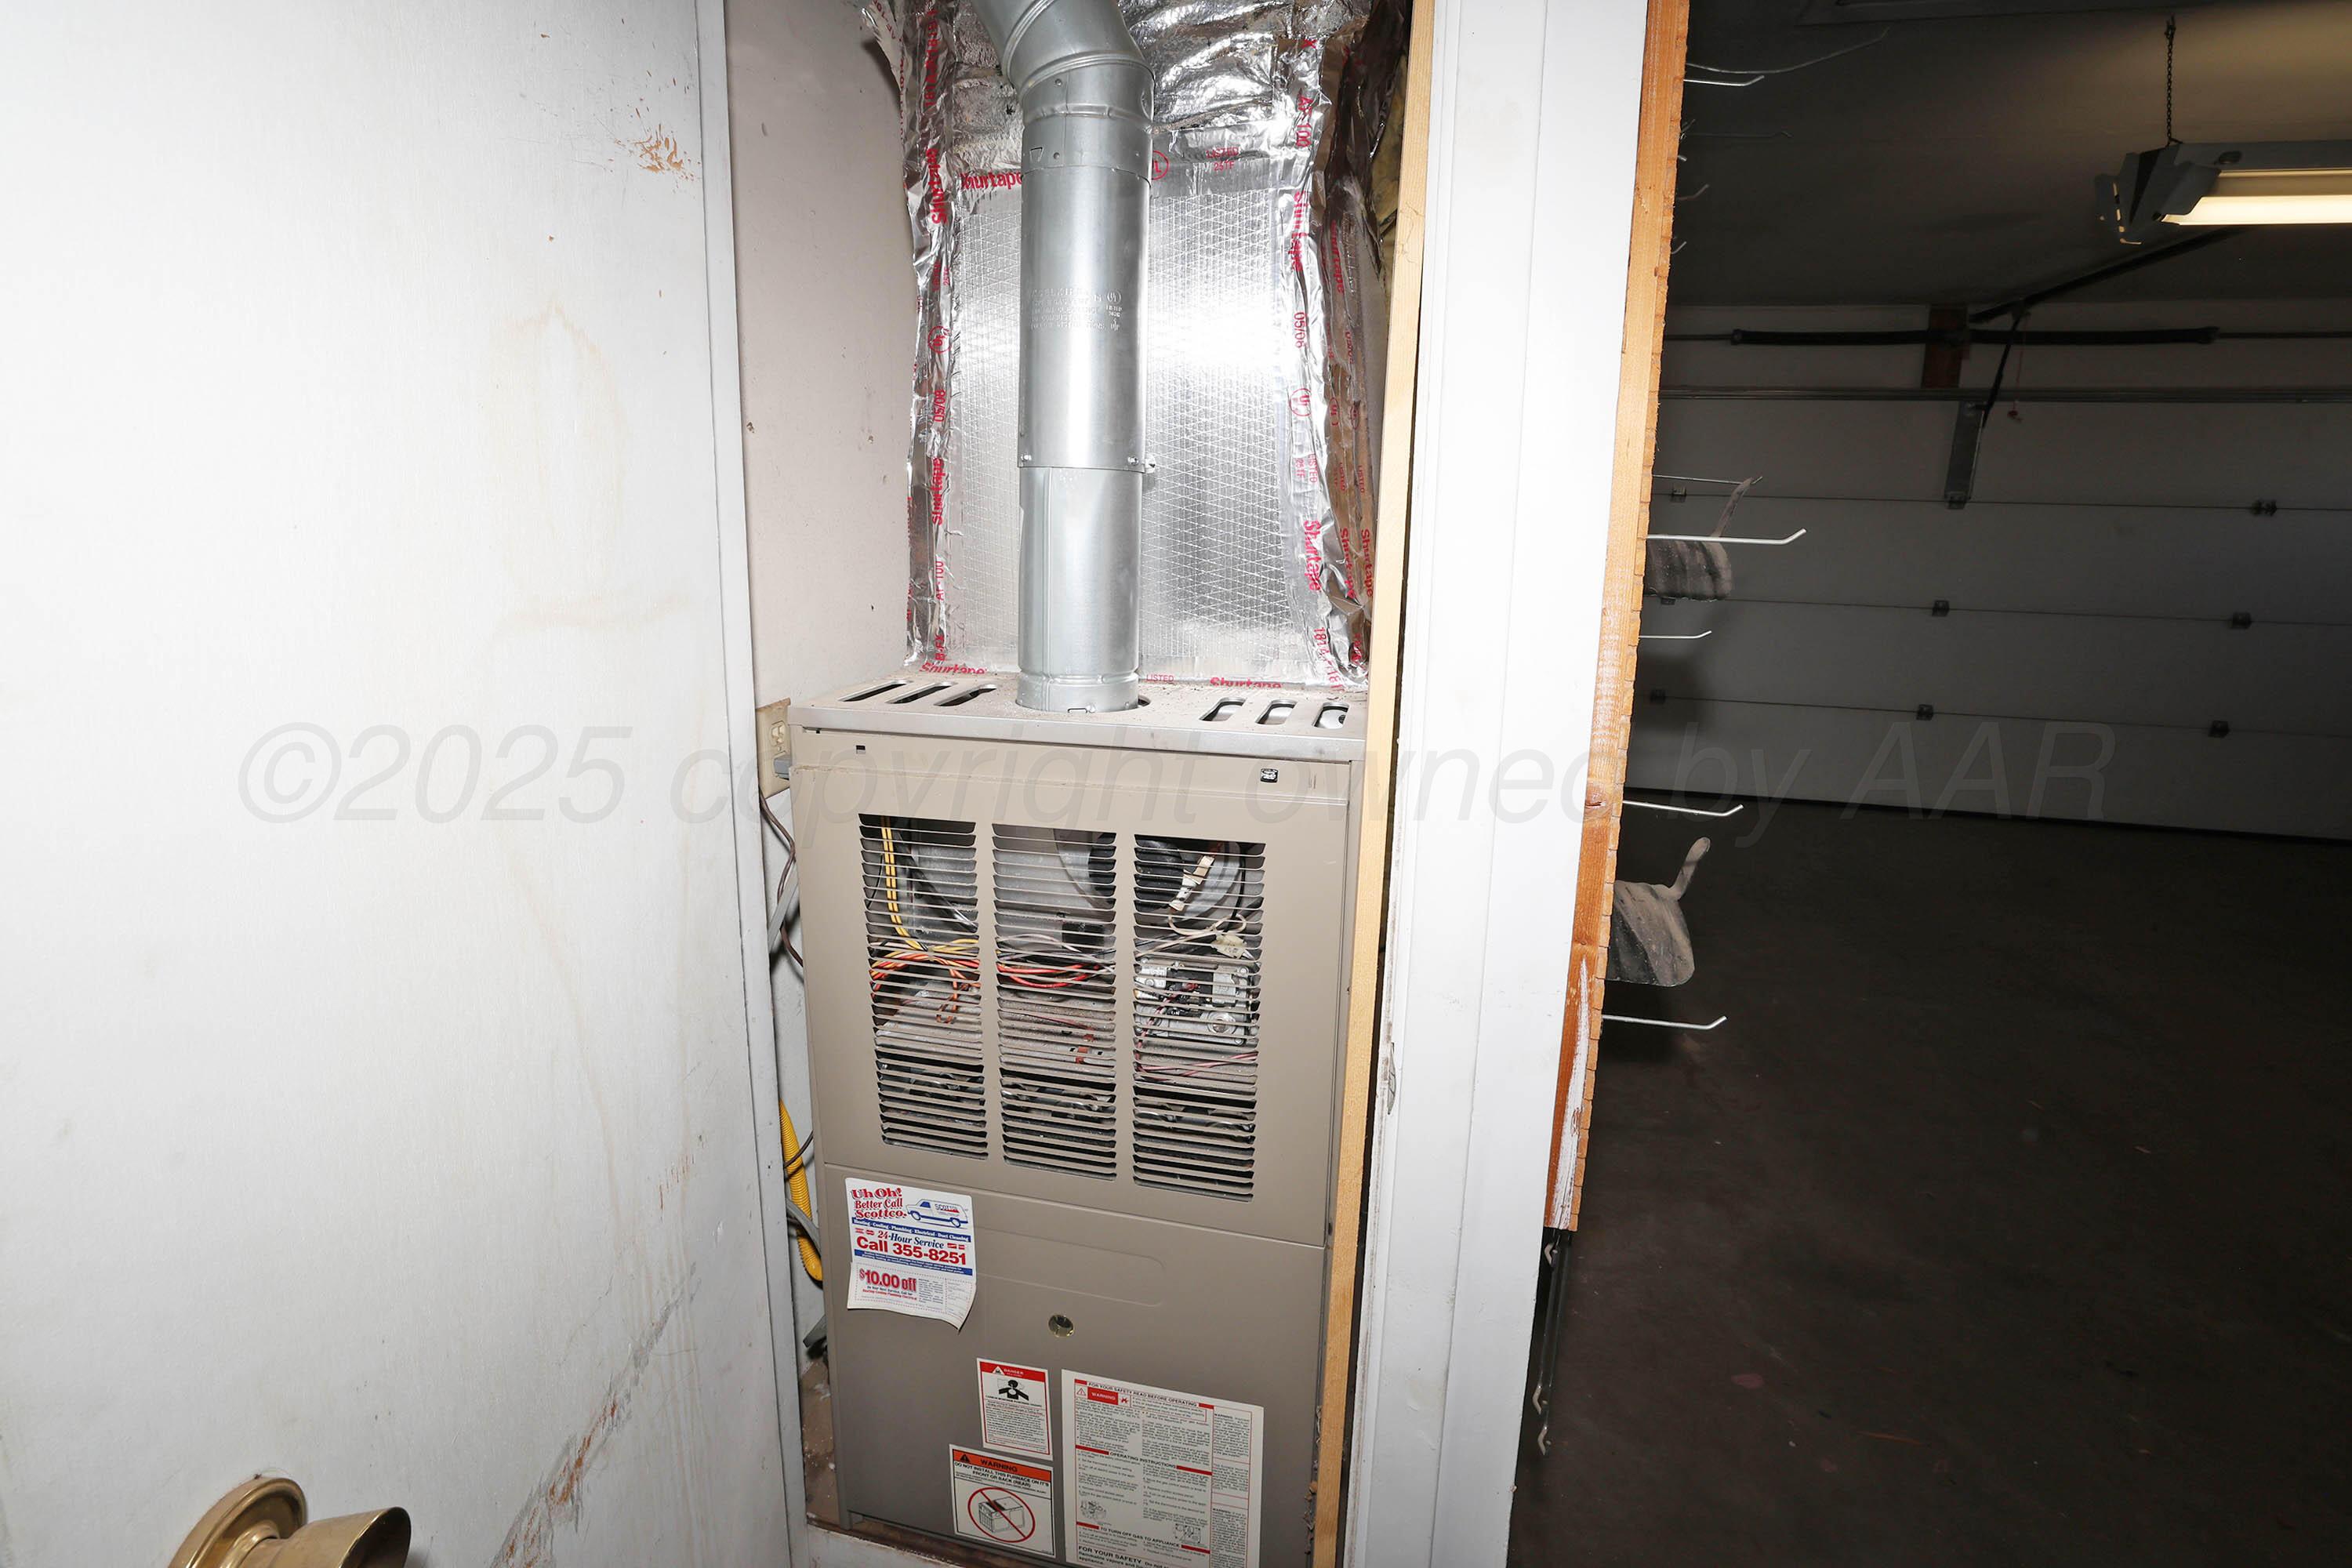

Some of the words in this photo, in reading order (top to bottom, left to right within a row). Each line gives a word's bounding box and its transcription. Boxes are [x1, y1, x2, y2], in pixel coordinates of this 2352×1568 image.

[1206, 147, 1240, 158] LISTED
[926, 148, 947, 223] Shurtape
[931, 457, 946, 526] Shurtape
[1303, 520, 1322, 591] Shurtape
[1360, 528, 1373, 597] Shurtape
[1146, 674, 1174, 683] LISTED
[851, 1189, 873, 1200] Uh
[874, 1188, 902, 1199] Oh!
[855, 1200, 883, 1210] Better
[884, 1198, 903, 1209] Call
[878, 1230, 913, 1244] 24-Hour
[913, 1236, 945, 1249] Service
[856, 1236, 888, 1253] Call
[892, 1242, 967, 1265] 355-8251
[859, 1269, 901, 1288] $10.00
[902, 1278, 917, 1292] off
[1091, 1392, 1116, 1400] WARNING
[1148, 1392, 1167, 1402] BEFORE
[1167, 1396, 1197, 1407] OPERATING
[980, 1459, 1018, 1472] WARNING
[1109, 1451, 1139, 1461] OPERATING
[1139, 1457, 1176, 1468] INSTRUCTIONS
[974, 1465, 994, 1475] INSTALL
[1007, 1473, 1030, 1483] FURNACE
[1013, 1479, 1031, 1488] (REAR)
[1152, 1537, 1179, 1548] APPLIANCE
[1094, 1548, 1114, 1558] YOUR
[1114, 1554, 1142, 1564] SAFETY
